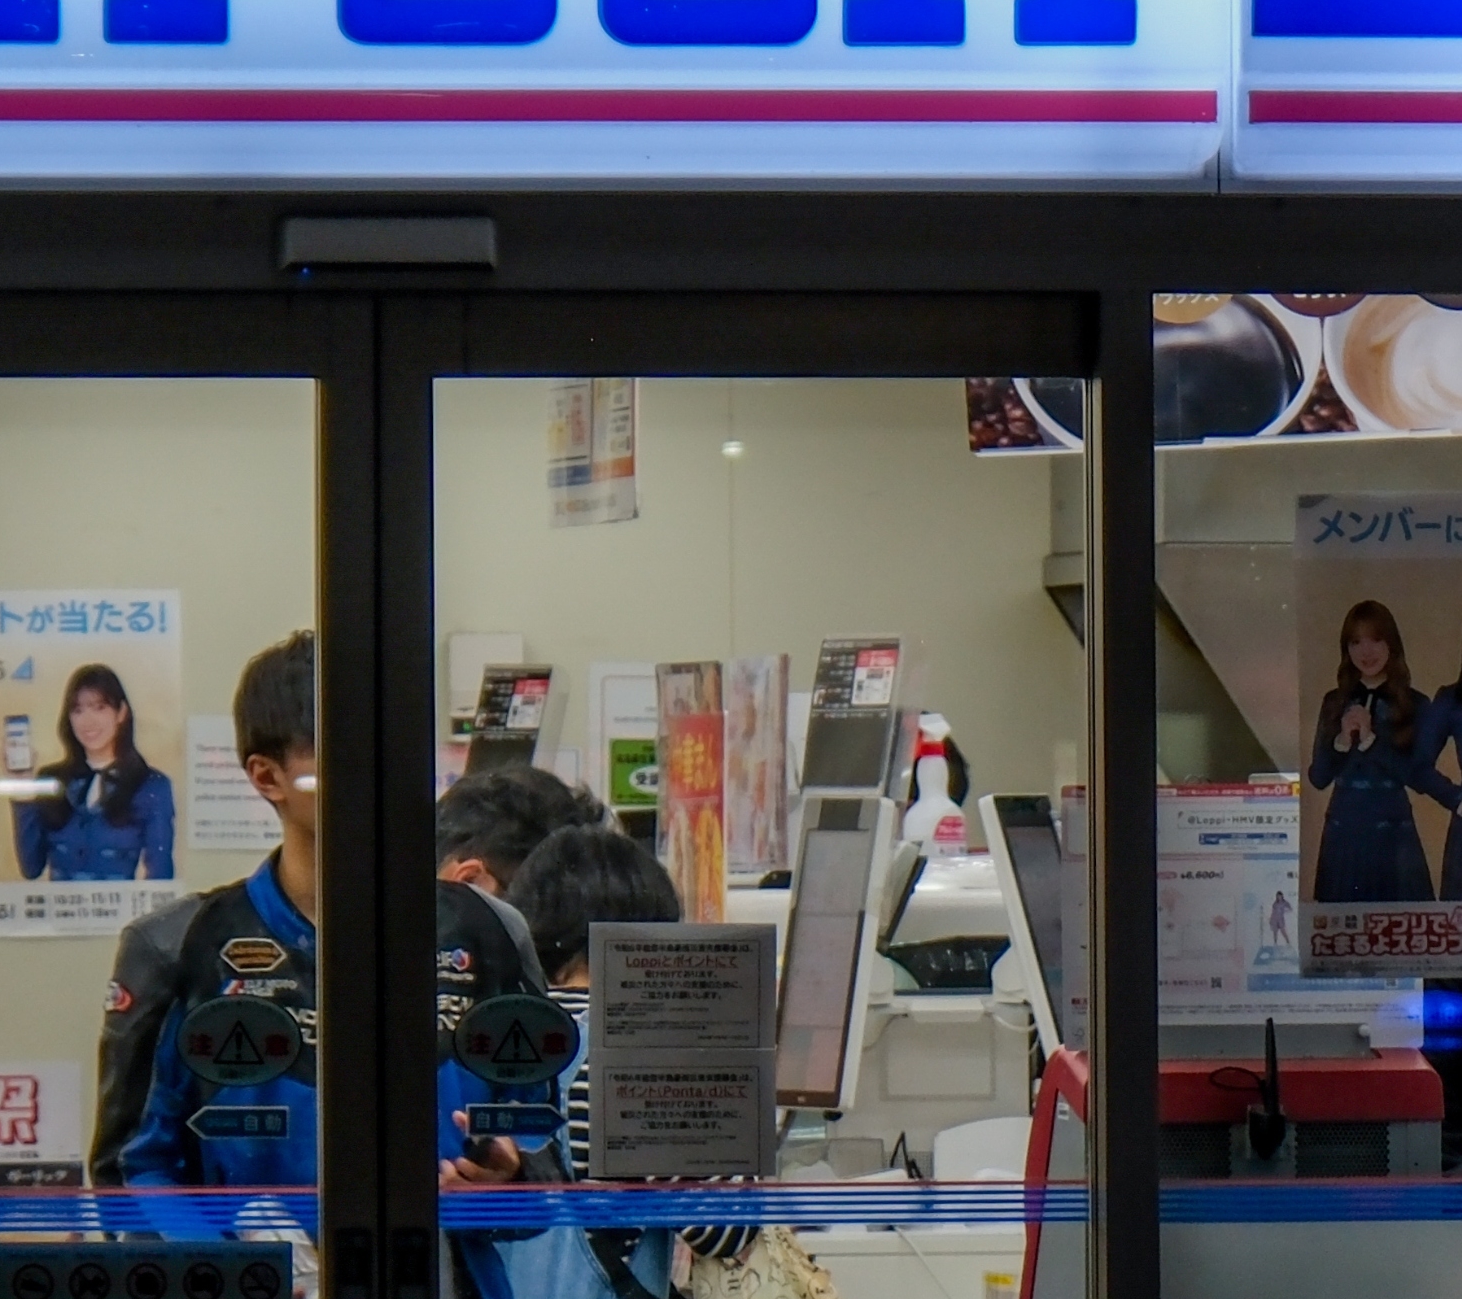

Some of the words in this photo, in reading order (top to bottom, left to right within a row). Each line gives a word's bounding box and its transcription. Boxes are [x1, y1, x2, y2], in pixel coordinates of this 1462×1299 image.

[626, 956, 737, 968] Loppiとポイントにて
